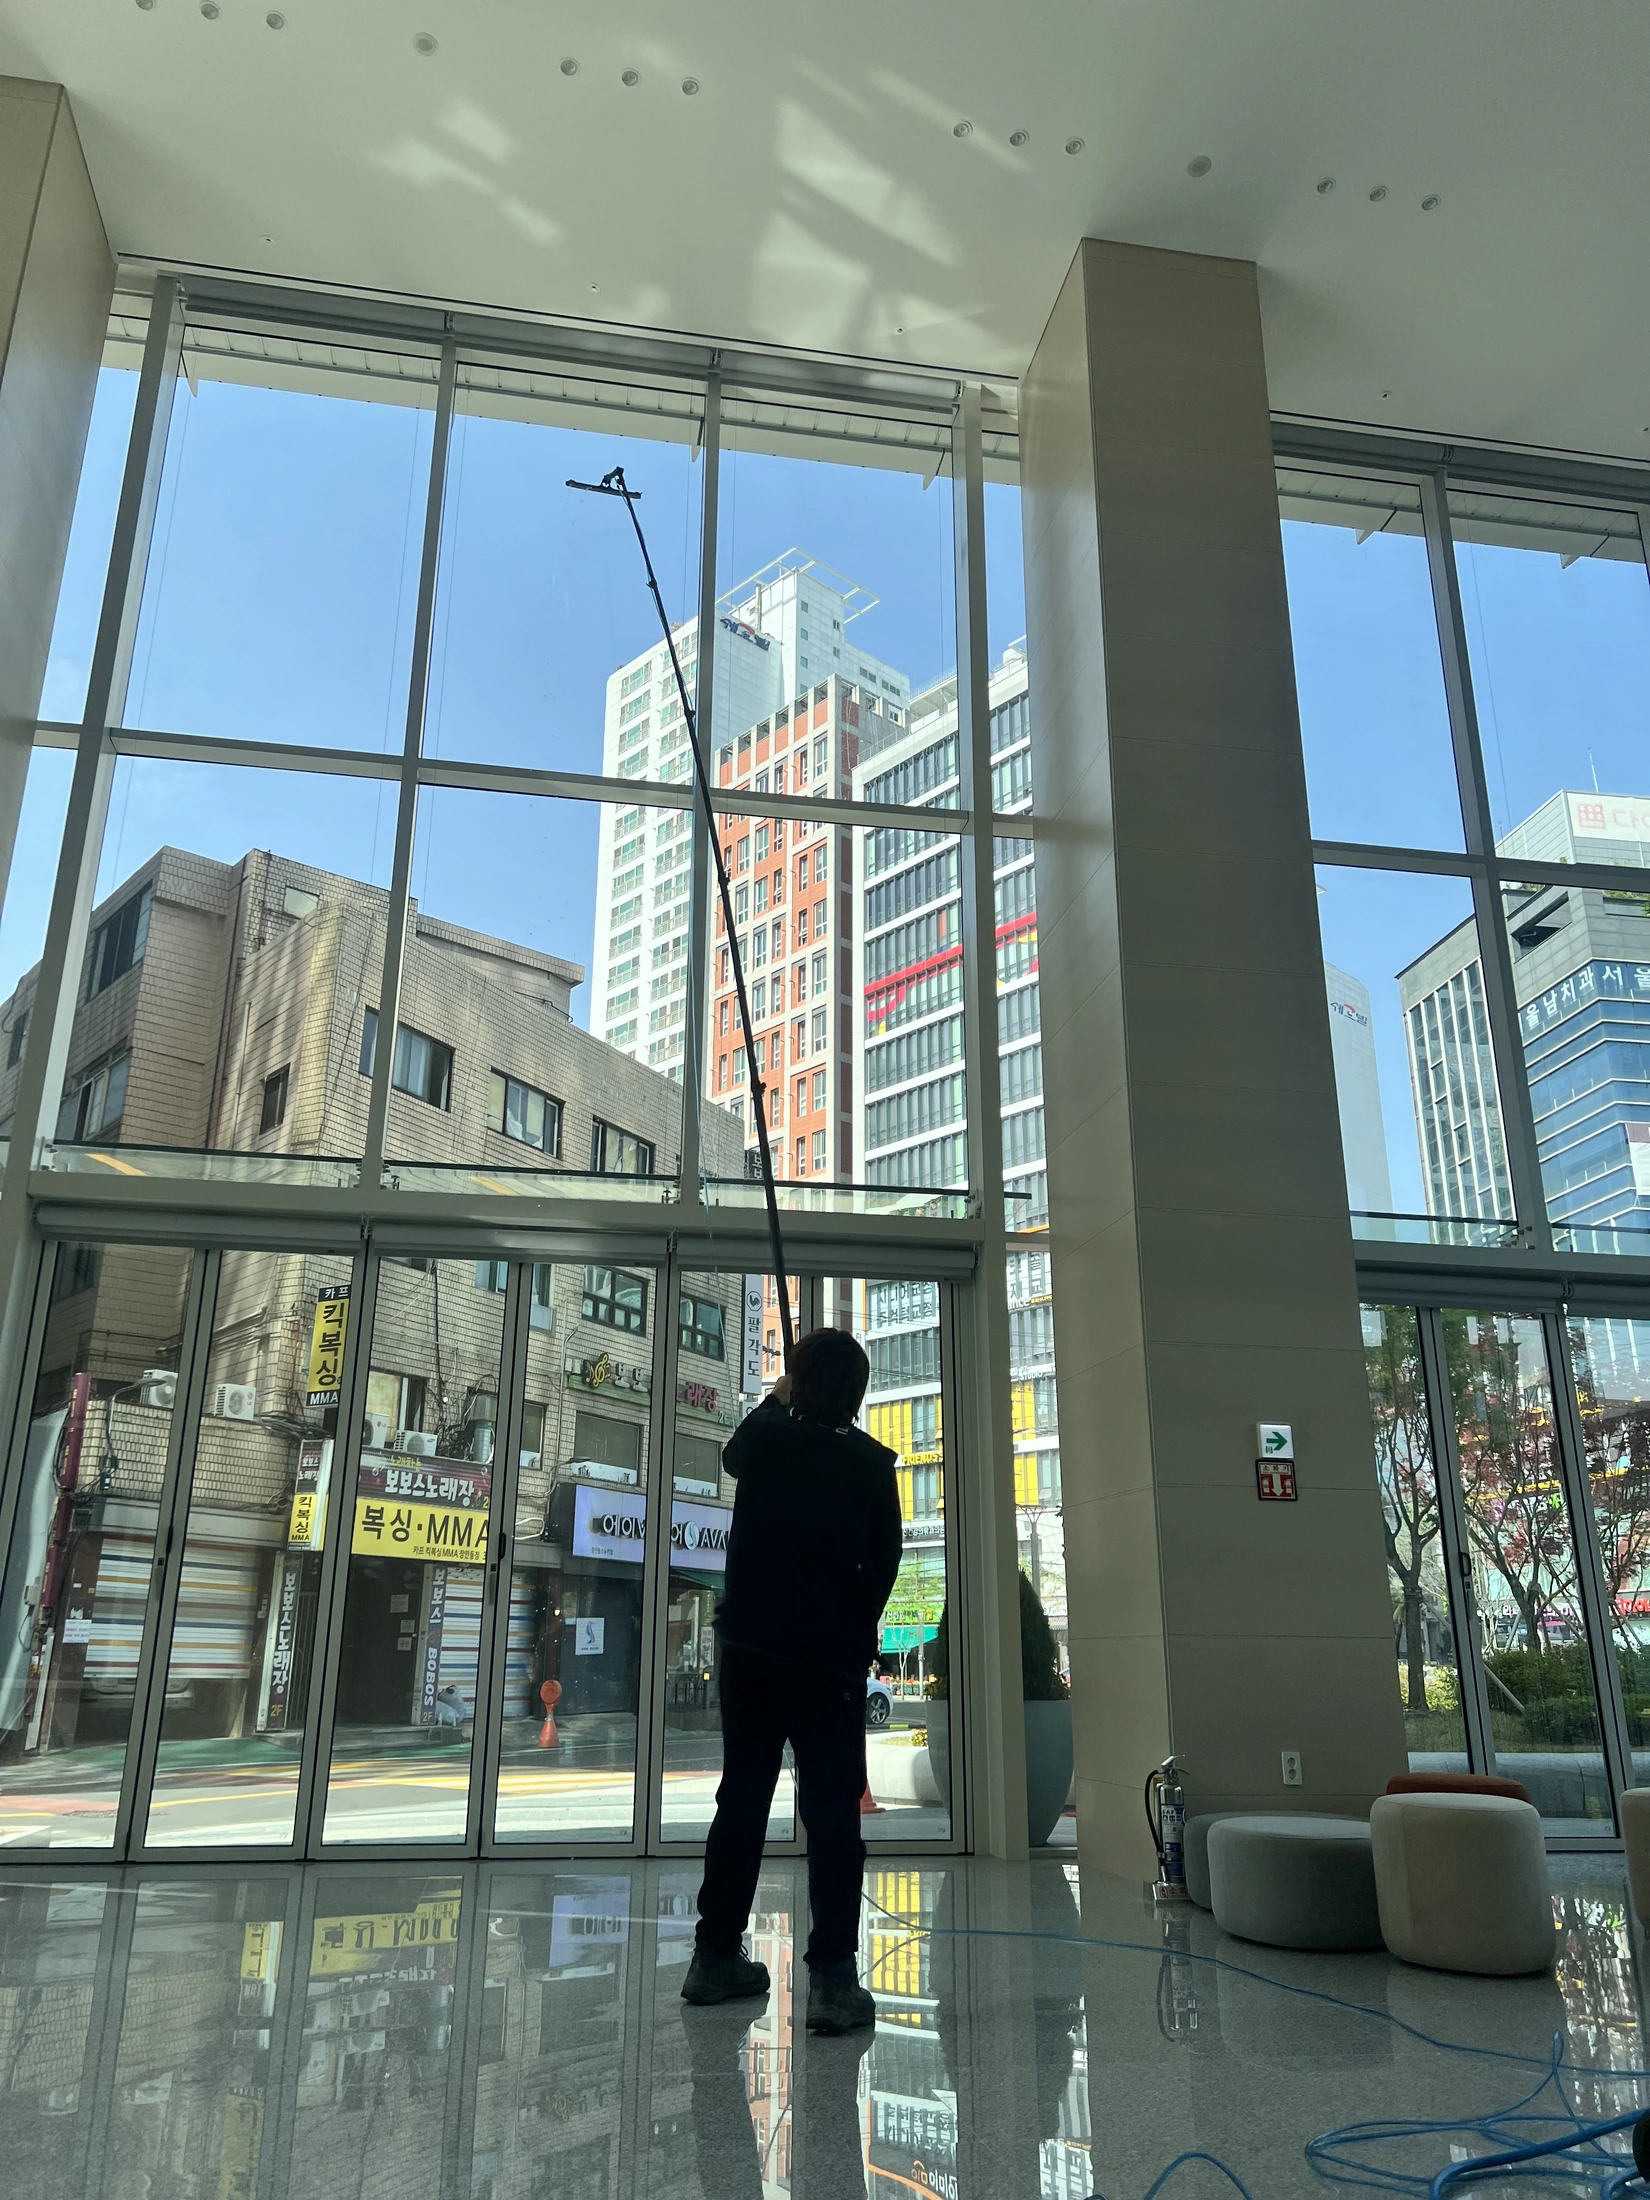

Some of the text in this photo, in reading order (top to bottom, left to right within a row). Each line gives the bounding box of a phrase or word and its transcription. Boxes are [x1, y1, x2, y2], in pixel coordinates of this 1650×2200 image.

[325, 1286, 348, 1298] 카프
[316, 1302, 345, 1386] 킥복싱
[747, 1316, 761, 1377] 팔각도
[310, 1391, 339, 1405] MMA
[385, 1469, 475, 1507] 보보스노래장
[295, 1496, 313, 1534] 킥복싱
[291, 1533, 310, 1541] MMA
[272, 1572, 297, 1695] 보보스노래장
[422, 1568, 447, 1722] 보보스 BOBOS 2F
[270, 1704, 284, 1717] 2F
